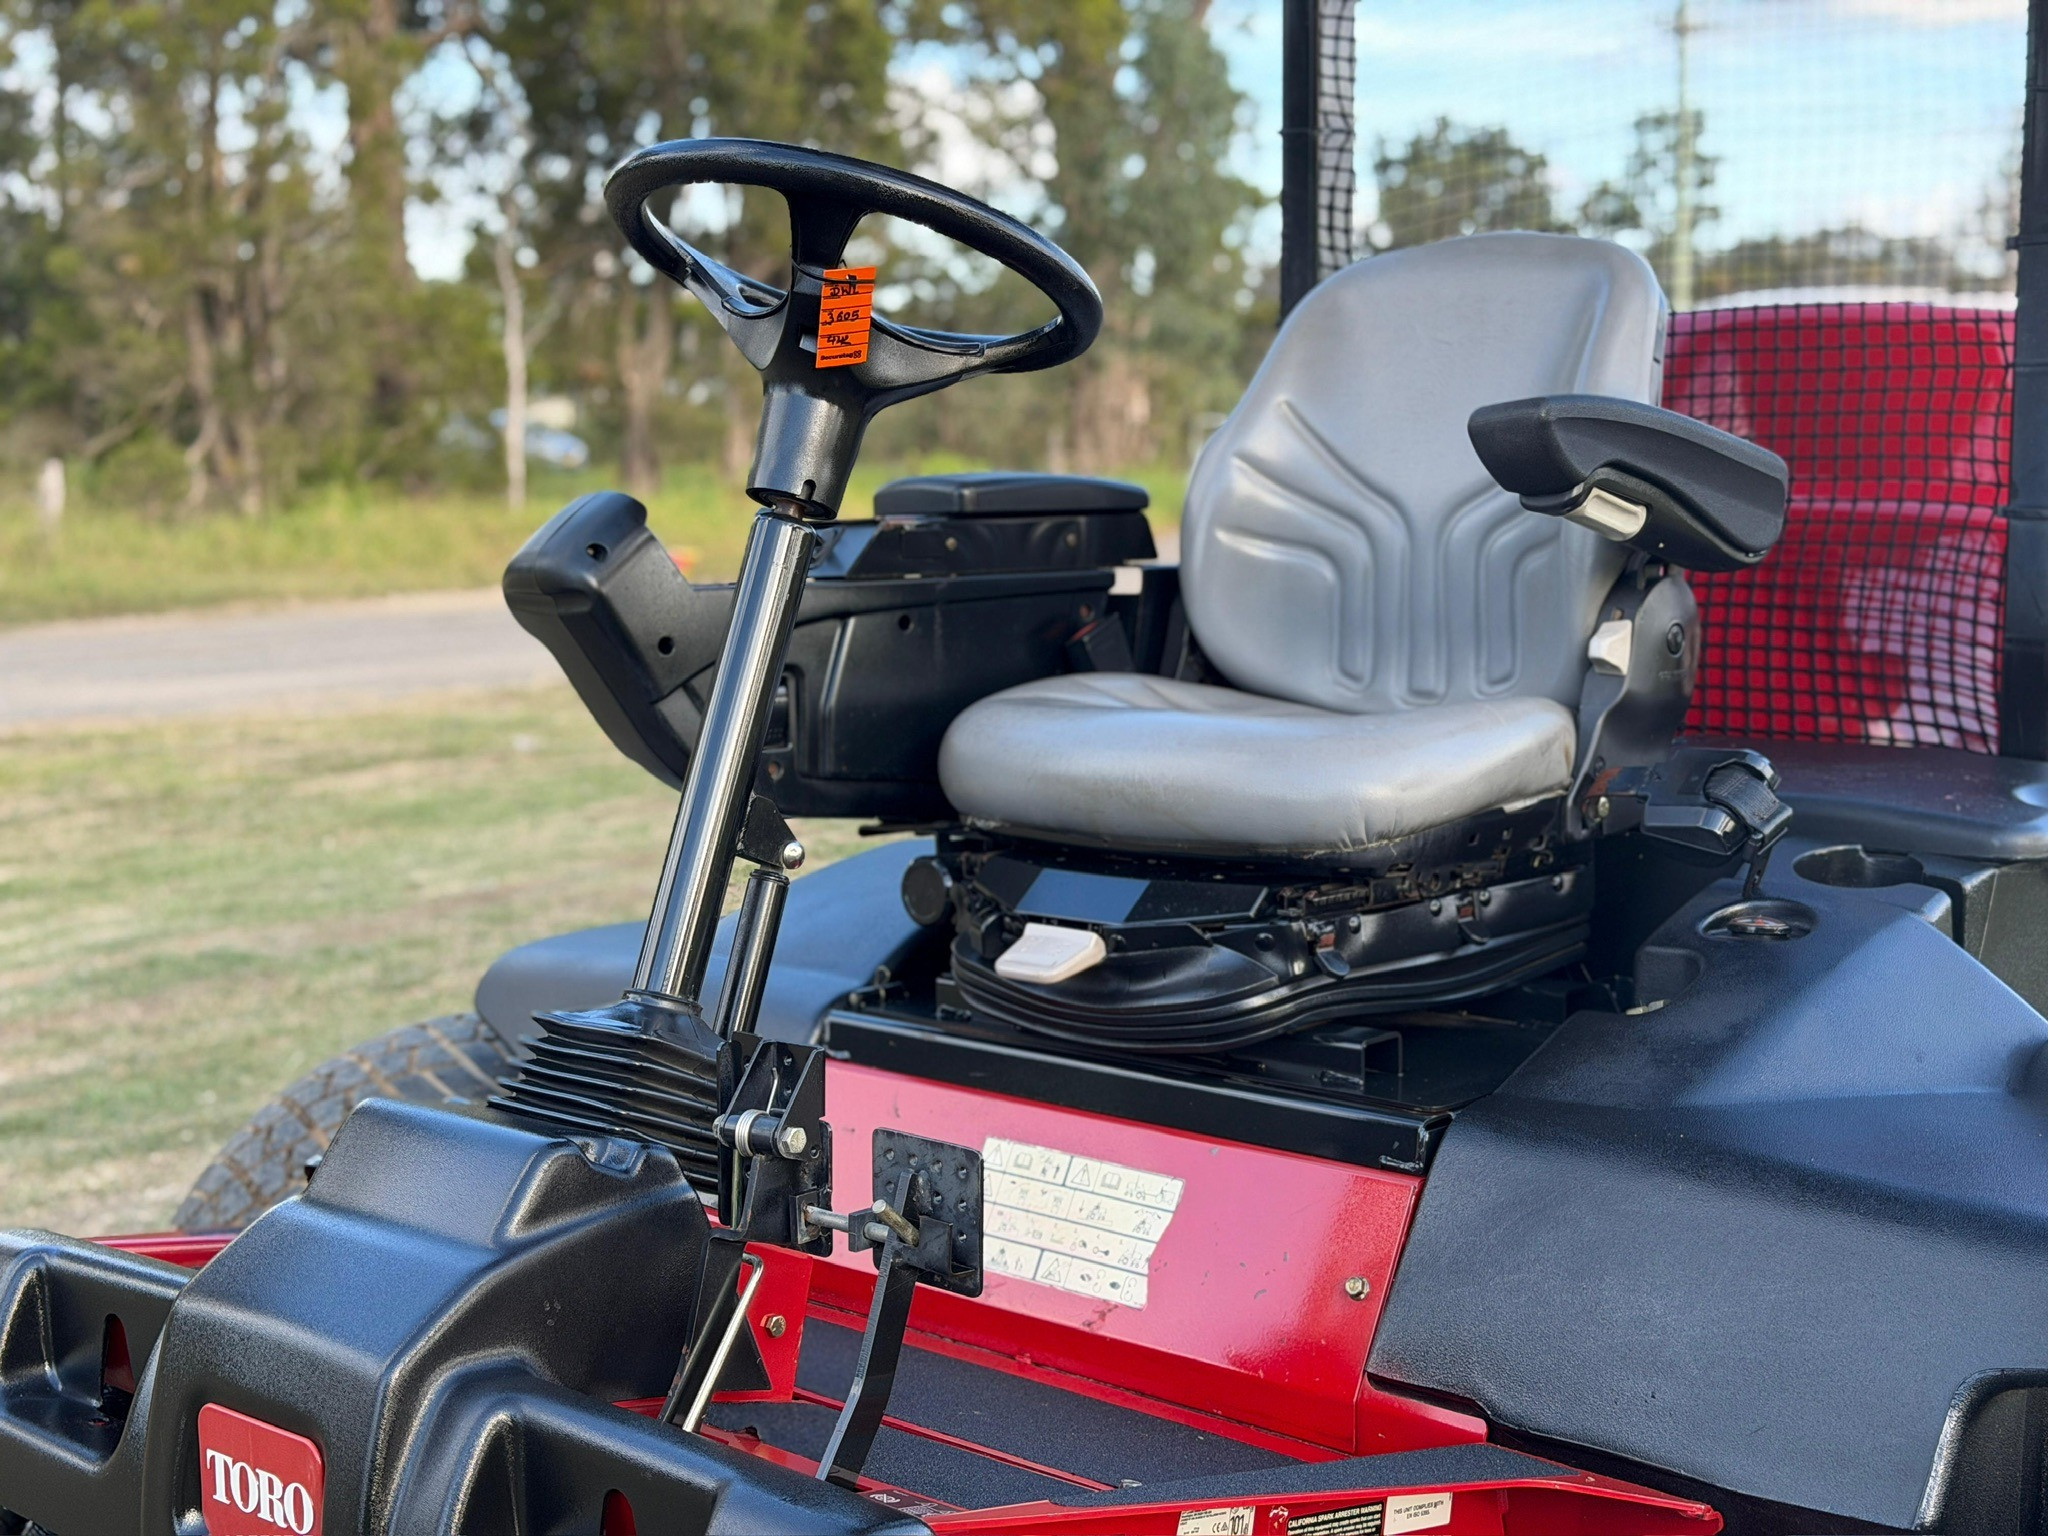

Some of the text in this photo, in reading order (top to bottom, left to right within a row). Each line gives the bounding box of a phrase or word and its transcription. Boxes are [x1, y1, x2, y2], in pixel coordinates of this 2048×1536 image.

[825, 310, 860, 325] 3605
[206, 1448, 314, 1535] TORO
[1288, 1504, 1382, 1528] CALIFORNIA SPARK ARRESTER WARNING
